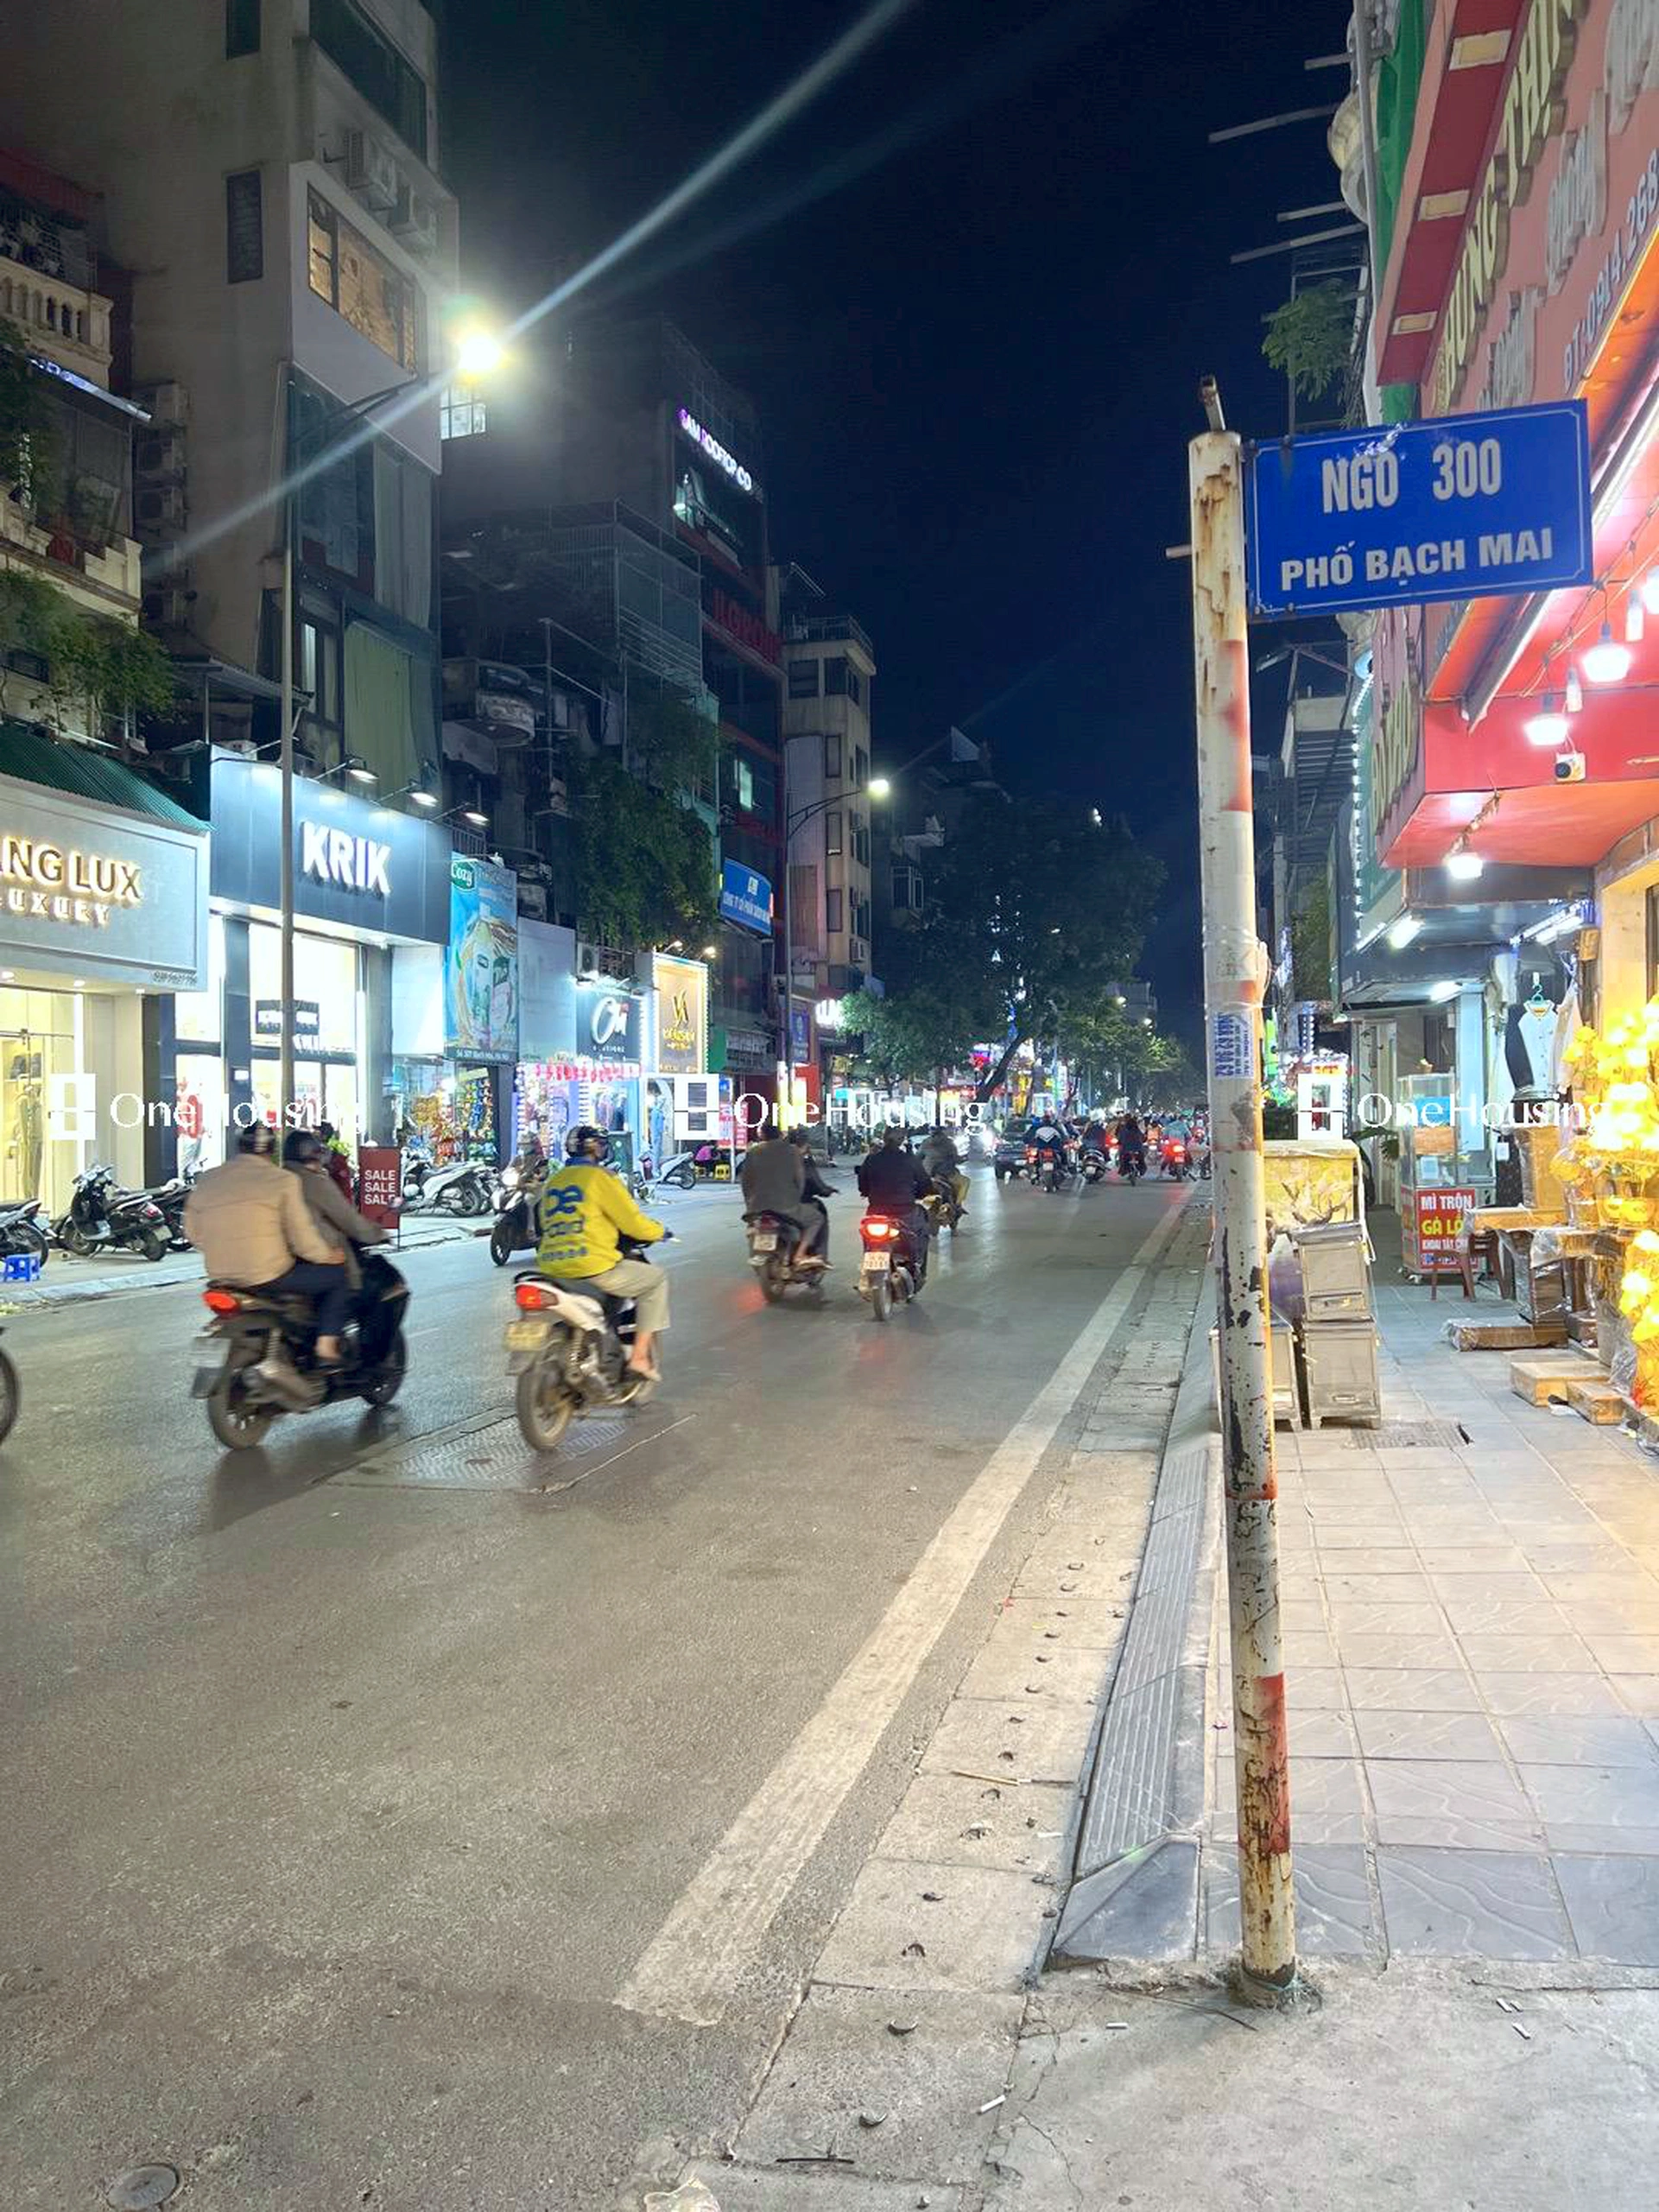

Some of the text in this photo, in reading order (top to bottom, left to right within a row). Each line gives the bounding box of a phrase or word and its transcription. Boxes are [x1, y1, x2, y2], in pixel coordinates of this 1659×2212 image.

[1433, 438, 1502, 501] 300
[1281, 527, 1553, 591] PHỐ BẠCH MAI
[300, 821, 392, 896] KRIK
[364, 1169, 396, 1181] SALE
[364, 1182, 396, 1193] SALE
[1421, 1193, 1438, 1211] MÌ
[1421, 1215, 1443, 1235] GÀ
